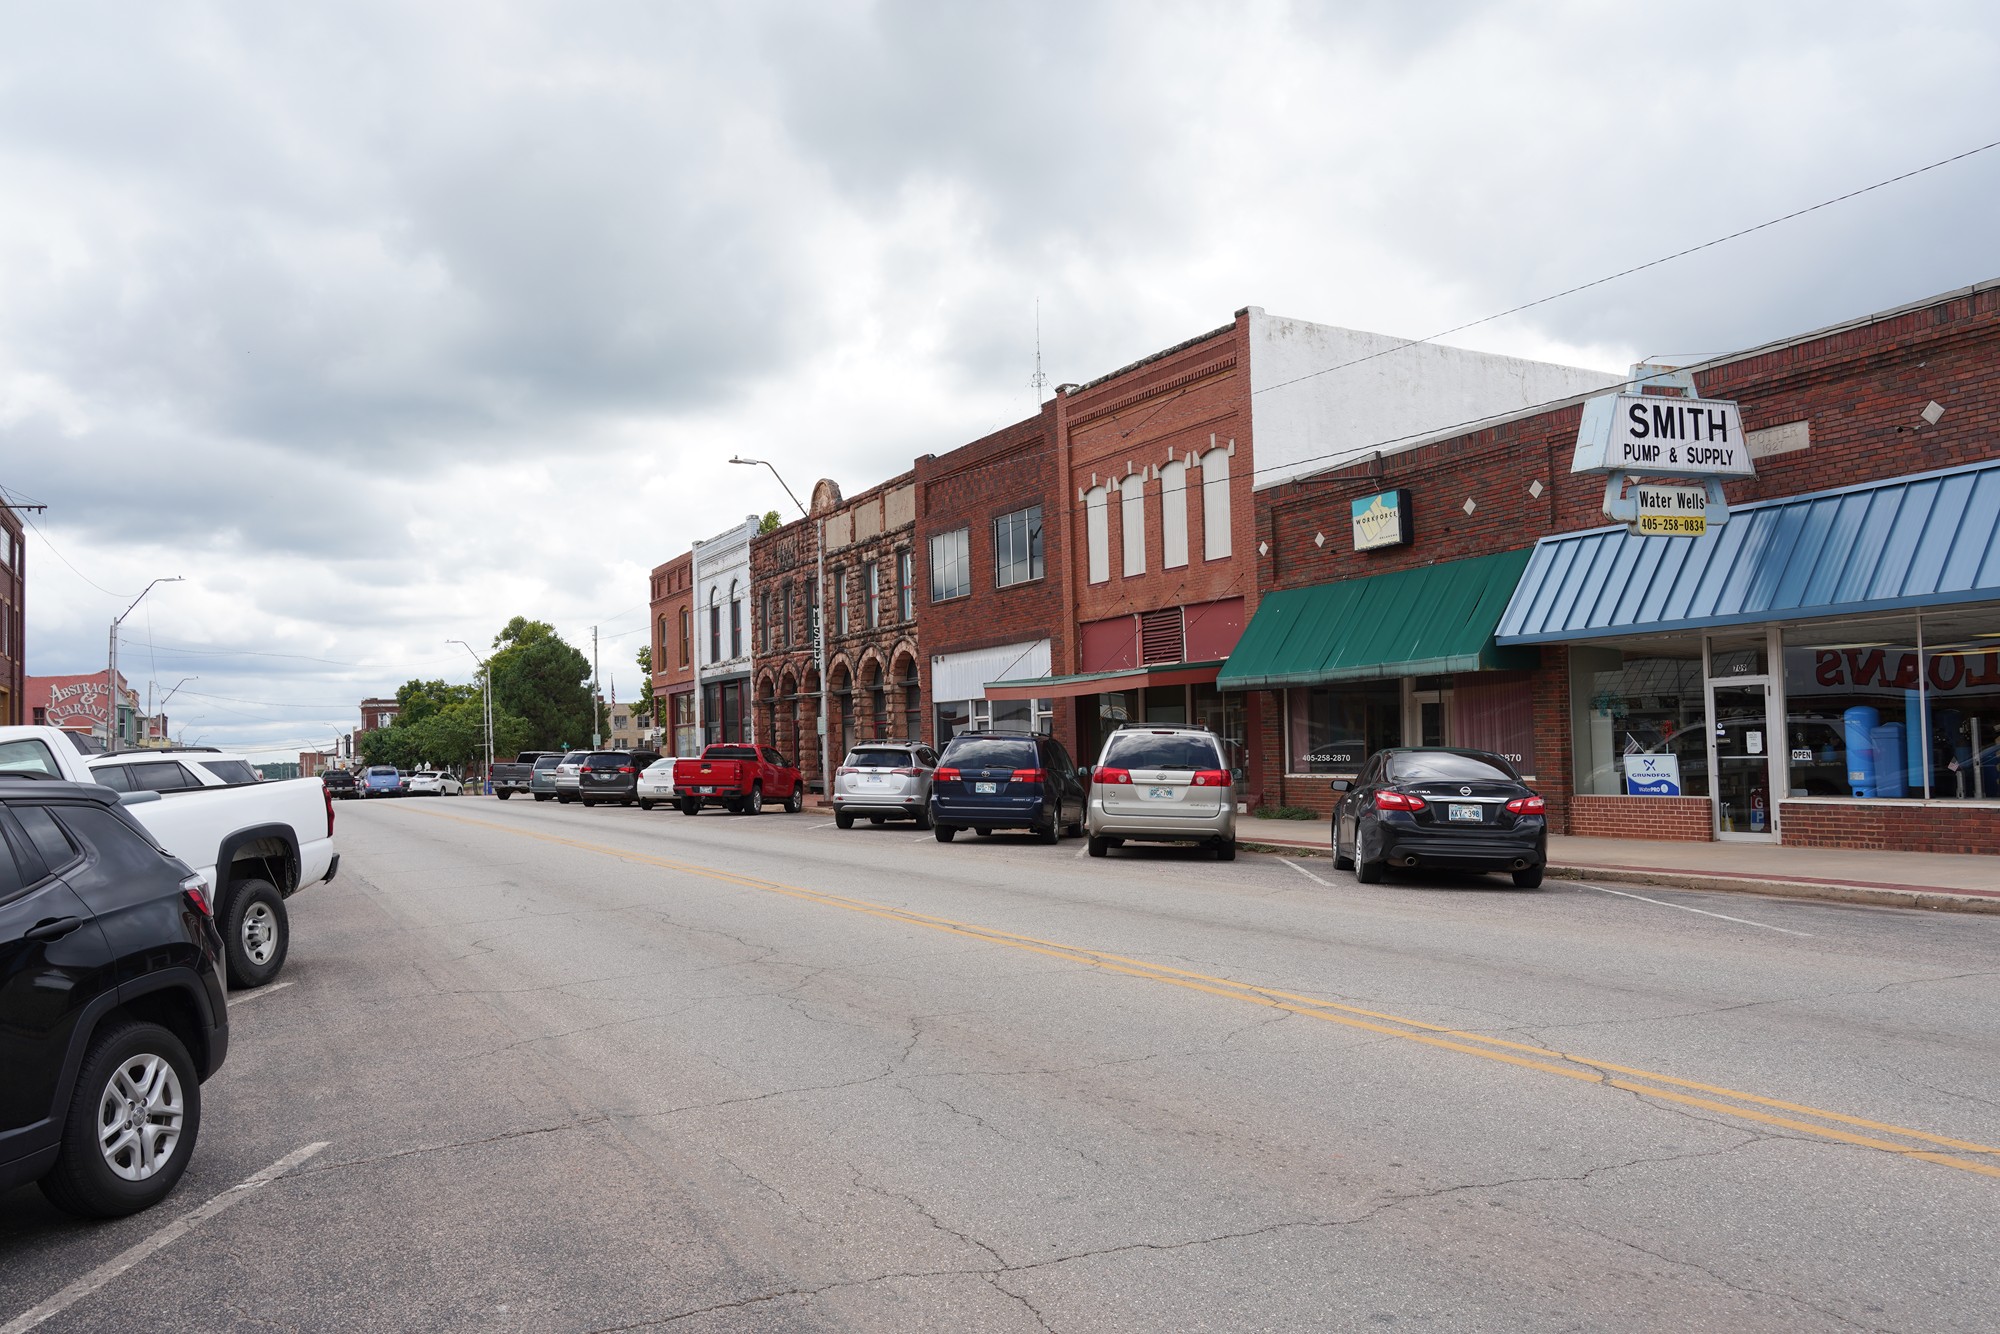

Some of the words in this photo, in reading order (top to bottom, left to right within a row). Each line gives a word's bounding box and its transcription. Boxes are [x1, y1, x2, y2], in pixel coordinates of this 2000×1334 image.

[1629, 403, 1727, 442] SMITH
[1748, 425, 1799, 447] POTTER
[1624, 443, 1660, 462] PUMP
[1669, 447, 1678, 463] &
[1687, 446, 1734, 466] SUPPLY
[1762, 440, 1784, 454] 1927
[1640, 491, 1672, 508] Water
[1677, 492, 1705, 509] Wells
[1355, 510, 1398, 525] WORKFORCE
[1641, 519, 1704, 531] 405-258-0834
[47, 682, 113, 705] ABSTRAC
[80, 692, 98, 705] &
[1302, 754, 1351, 762] 405-258-2870
[1793, 750, 1811, 760] OPEN
